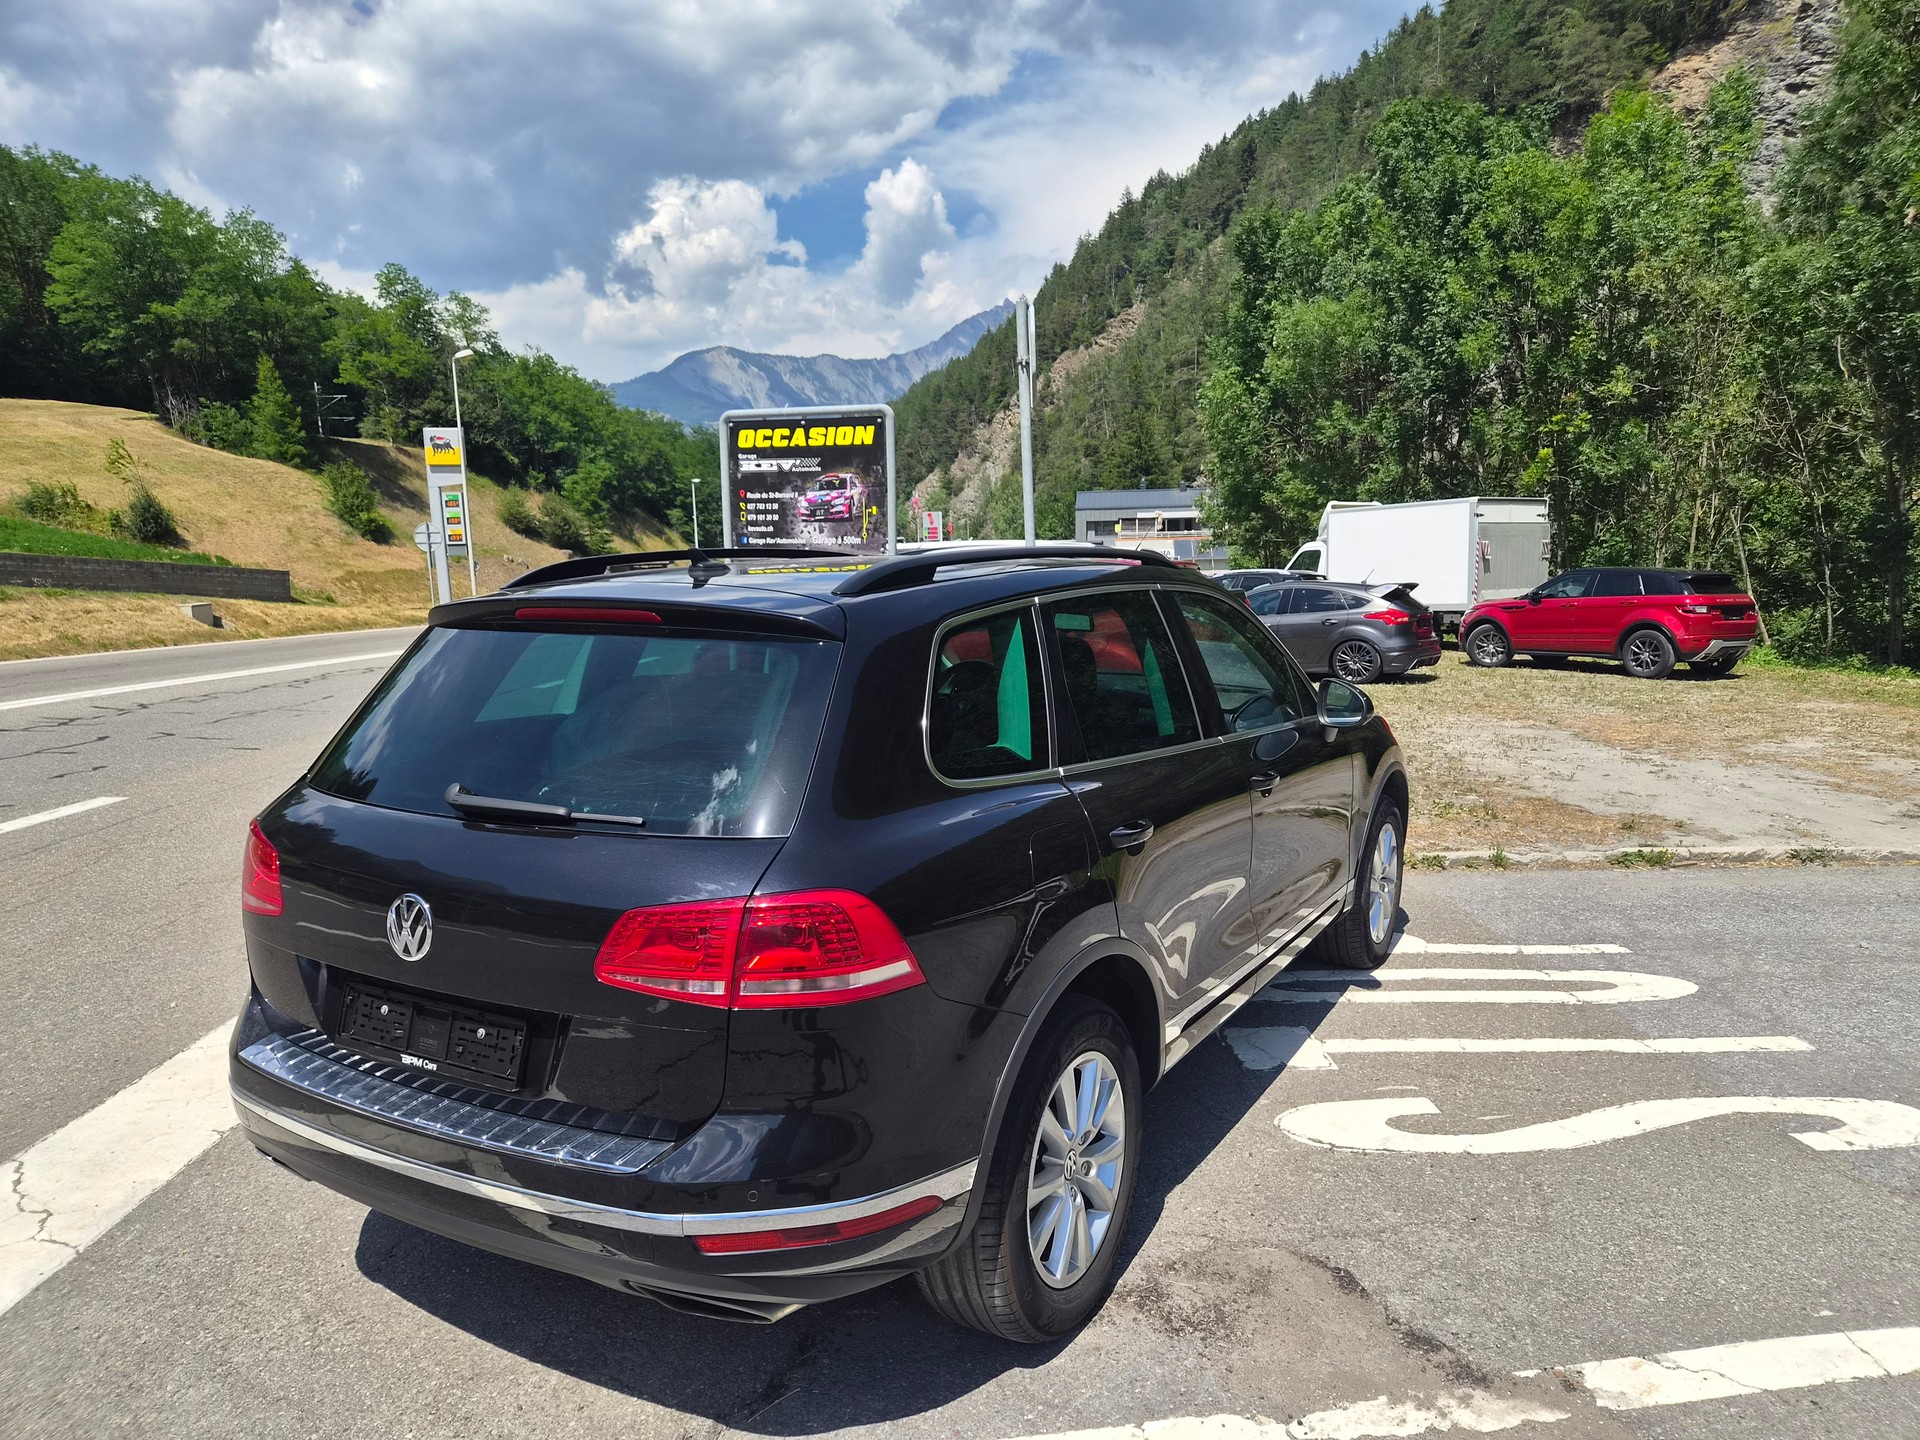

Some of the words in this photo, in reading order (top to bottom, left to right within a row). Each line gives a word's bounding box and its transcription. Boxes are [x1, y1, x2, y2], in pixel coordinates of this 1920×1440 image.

[738, 426, 875, 448] OCCASION
[748, 537, 765, 545] Garage
[812, 536, 837, 546] Garage
[843, 535, 862, 545] 500m
[423, 1059, 438, 1071] Cars
